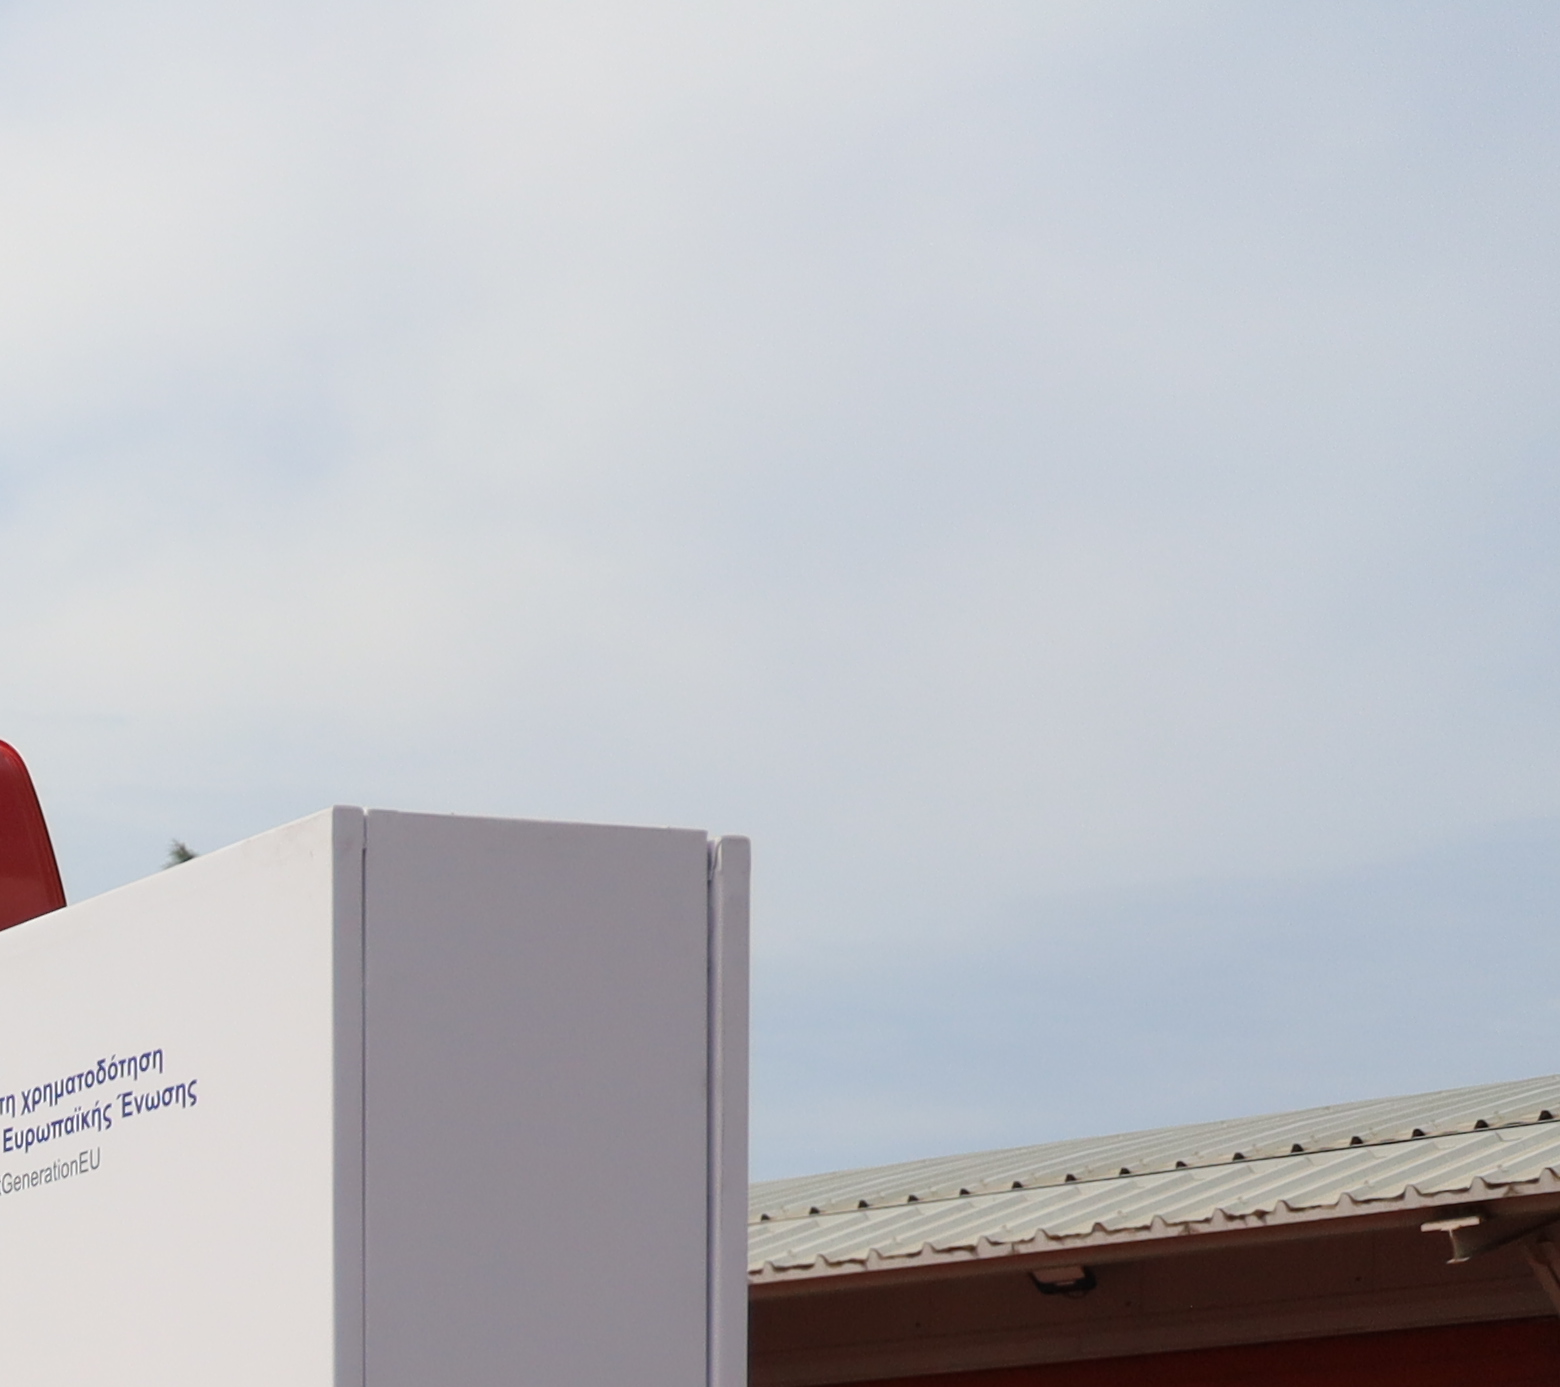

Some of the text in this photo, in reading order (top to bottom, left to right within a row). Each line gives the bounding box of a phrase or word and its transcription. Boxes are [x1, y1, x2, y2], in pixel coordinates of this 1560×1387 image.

[3, 1101, 112, 1153] Ευρωπαϊκής
[117, 1079, 197, 1118] Ένωσης
[21, 1048, 163, 1115] χρηματοδότηση
